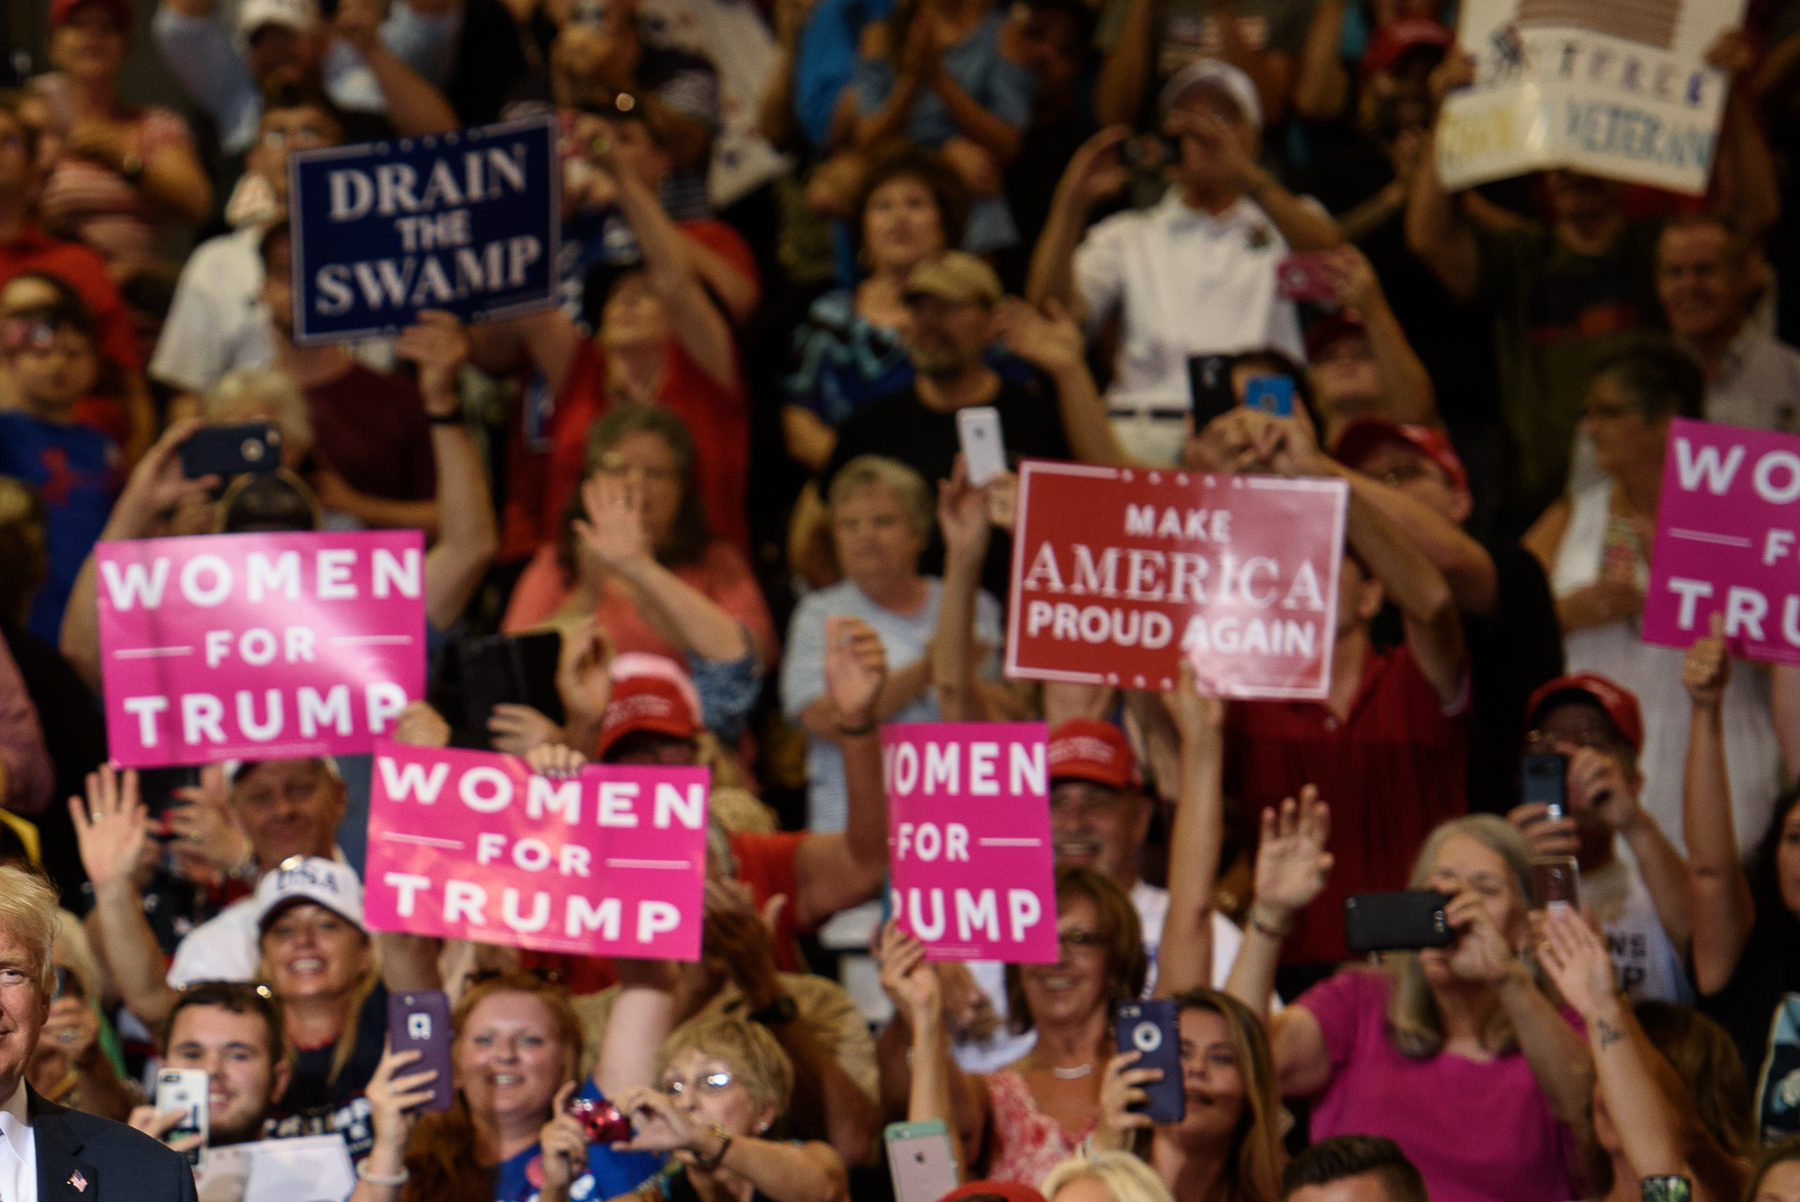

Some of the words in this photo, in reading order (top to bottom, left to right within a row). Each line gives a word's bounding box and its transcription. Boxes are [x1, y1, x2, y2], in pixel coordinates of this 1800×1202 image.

[328, 143, 527, 223] DRAIN
[395, 208, 472, 252] THE
[315, 235, 541, 316] SWAMP
[1124, 504, 1232, 543] MAKE
[101, 548, 422, 612] WOMEN
[1023, 541, 1325, 612] AMERICA
[205, 625, 316, 668] FOR
[1027, 600, 1173, 649] PROUD
[1180, 615, 1315, 659] AGAIN
[123, 681, 407, 748] TRUMP
[378, 756, 705, 829] WOMEN
[884, 741, 1047, 796] OMEN
[477, 832, 591, 877] FOR
[384, 871, 681, 943] TRUMP
